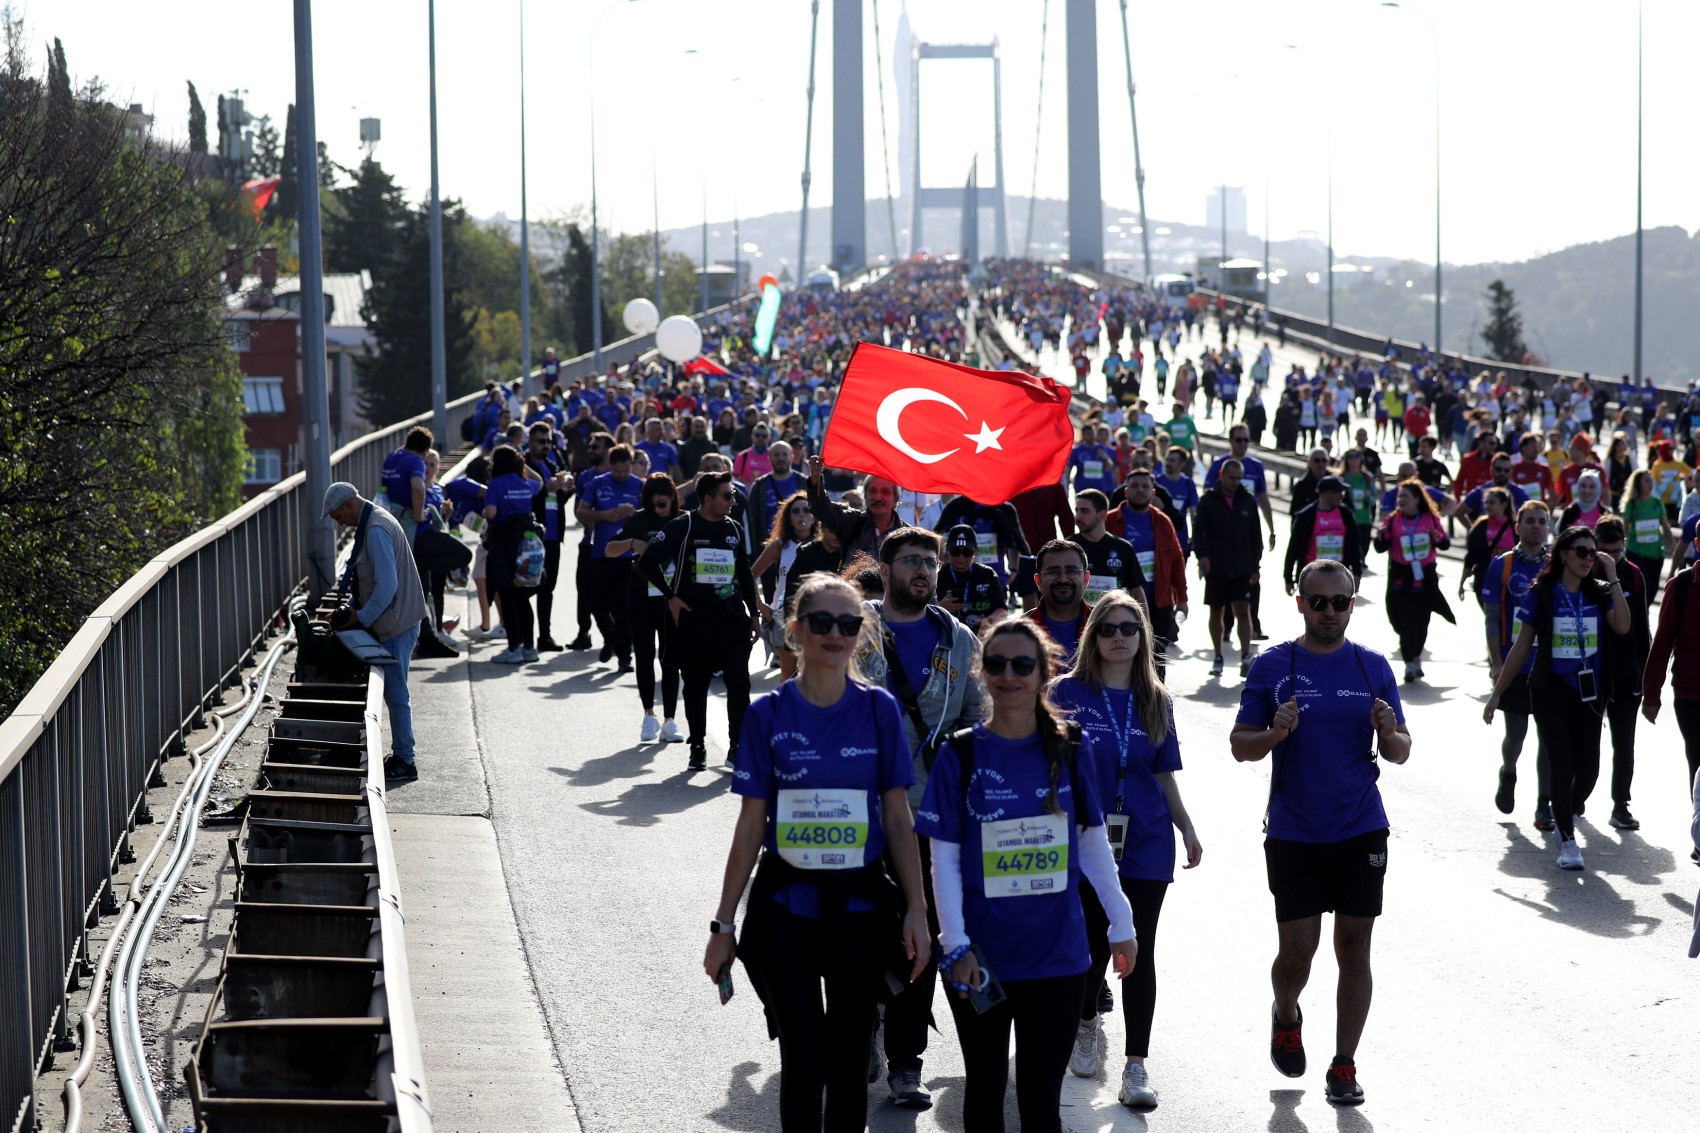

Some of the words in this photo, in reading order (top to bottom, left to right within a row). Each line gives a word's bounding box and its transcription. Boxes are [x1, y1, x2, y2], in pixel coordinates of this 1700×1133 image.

[704, 565, 729, 573] 45761
[1559, 636, 1590, 646] 3821
[786, 826, 856, 844] 44808
[996, 850, 1059, 872] 44789
